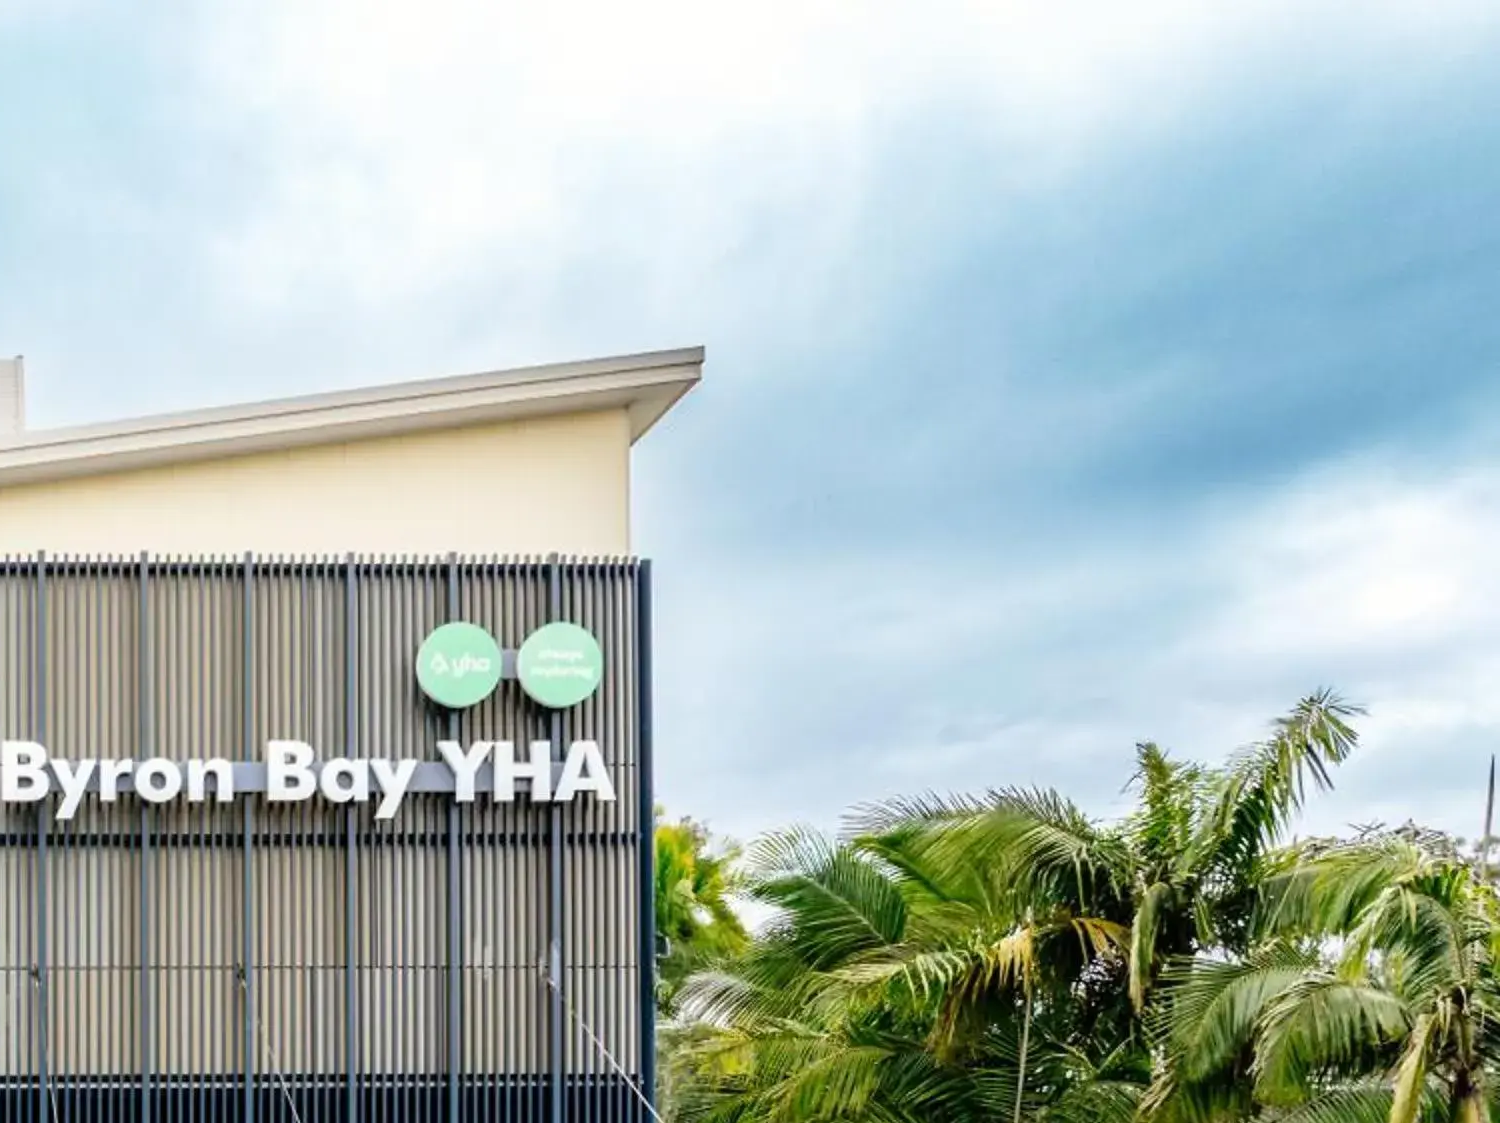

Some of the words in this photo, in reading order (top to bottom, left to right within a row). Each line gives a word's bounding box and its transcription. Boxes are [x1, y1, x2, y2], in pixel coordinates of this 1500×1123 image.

[452, 651, 491, 678] yha
[1, 740, 235, 820] Byron
[267, 740, 418, 820] Bay
[437, 739, 617, 803] YHA
